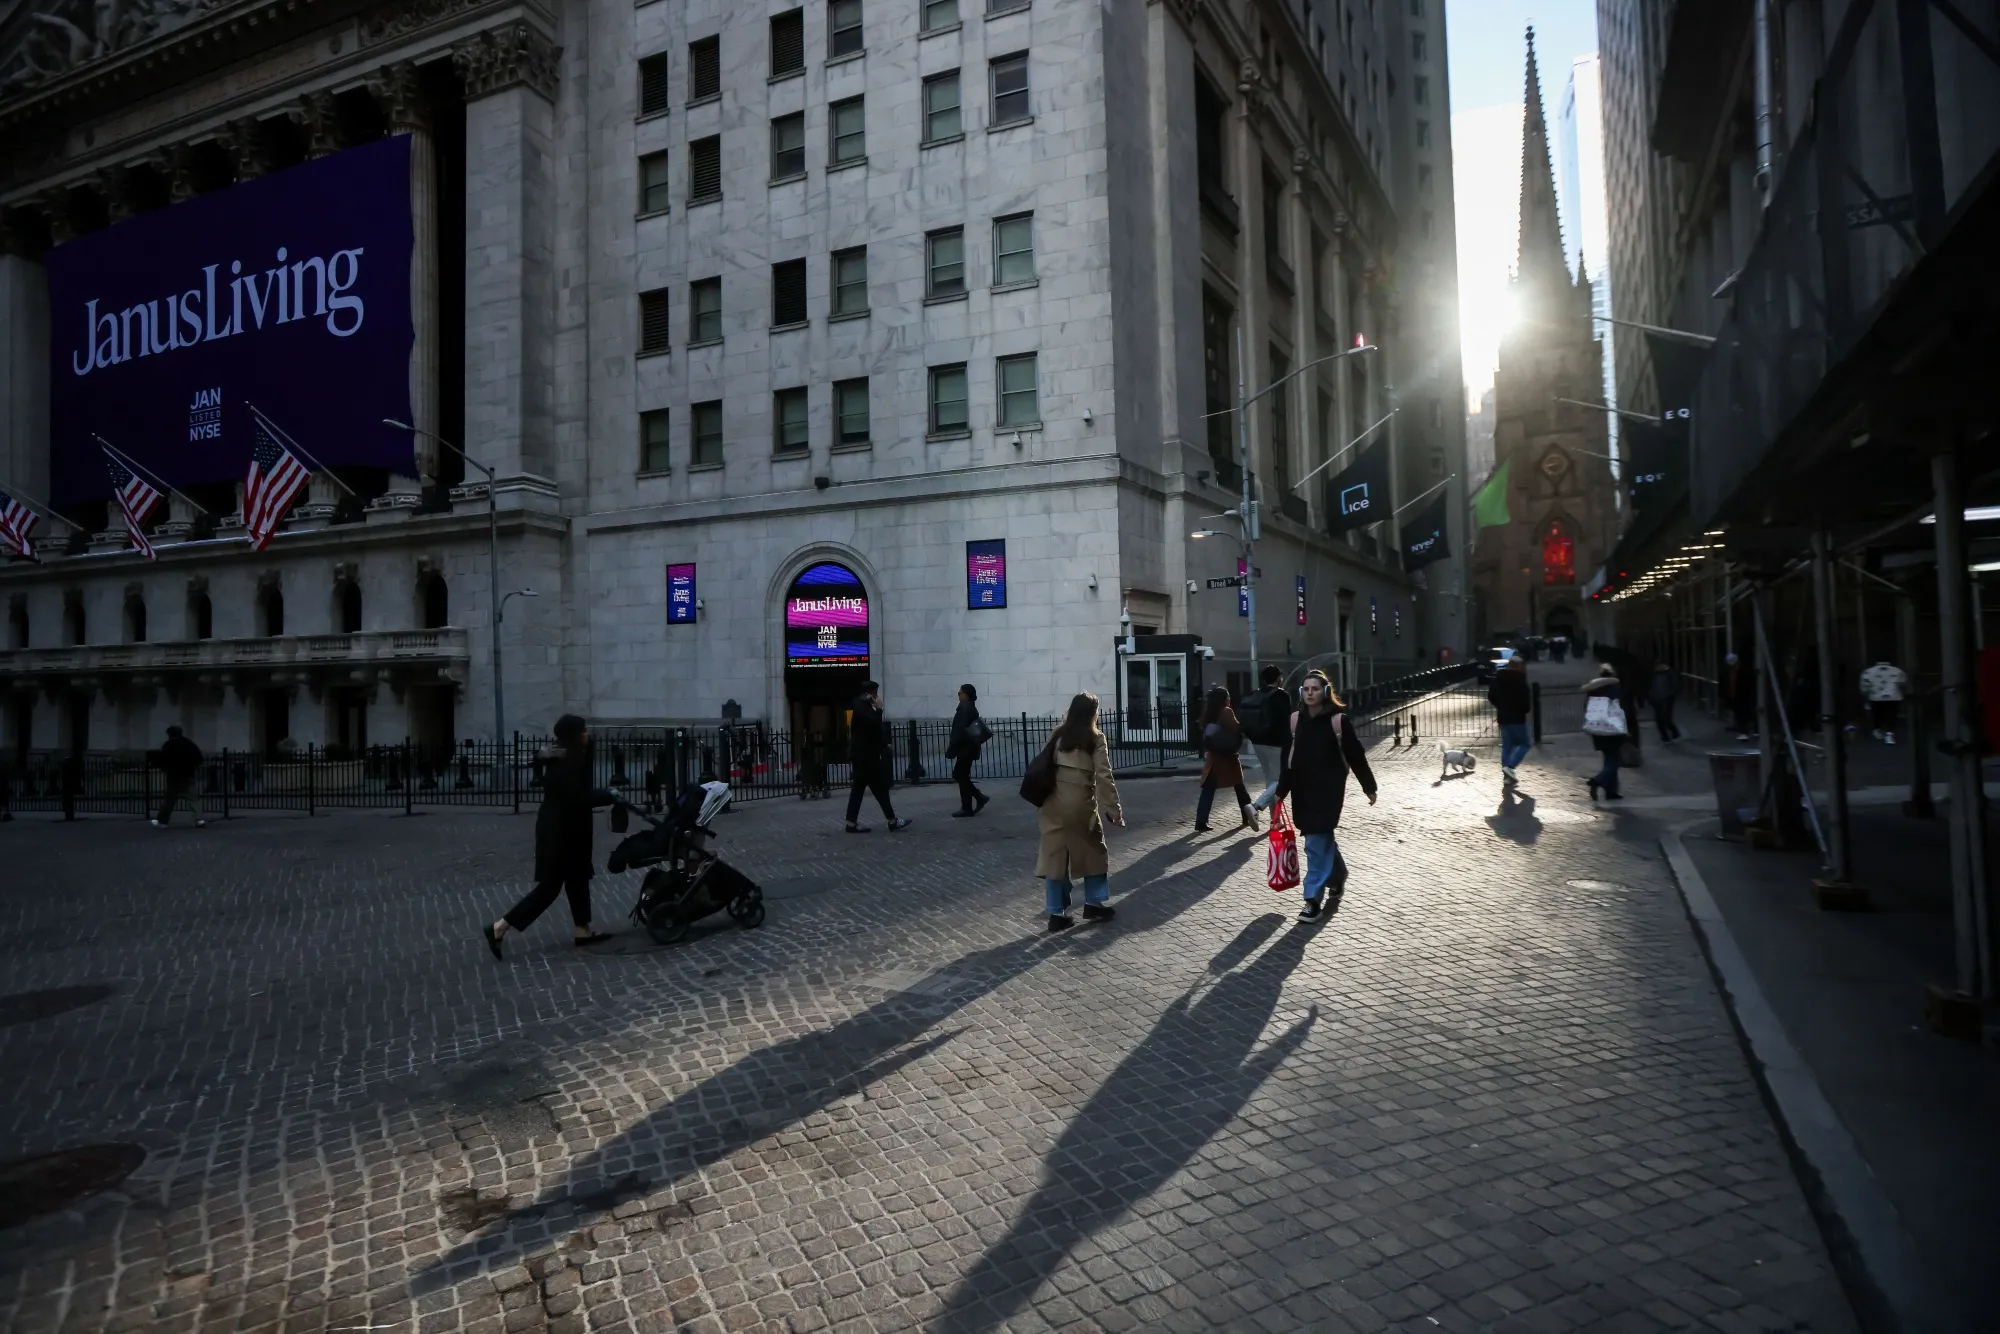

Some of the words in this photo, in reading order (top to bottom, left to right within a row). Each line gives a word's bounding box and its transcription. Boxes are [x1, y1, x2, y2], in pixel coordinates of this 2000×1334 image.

[73, 246, 364, 376] JanusLiving
[190, 387, 221, 410] JAN
[190, 410, 221, 423] LISTED
[190, 422, 221, 442] NYSE
[1211, 579, 1227, 589] Broad
[792, 596, 862, 614] JanusLiving
[818, 626, 837, 634] JAN
[818, 641, 838, 649] NYSE
